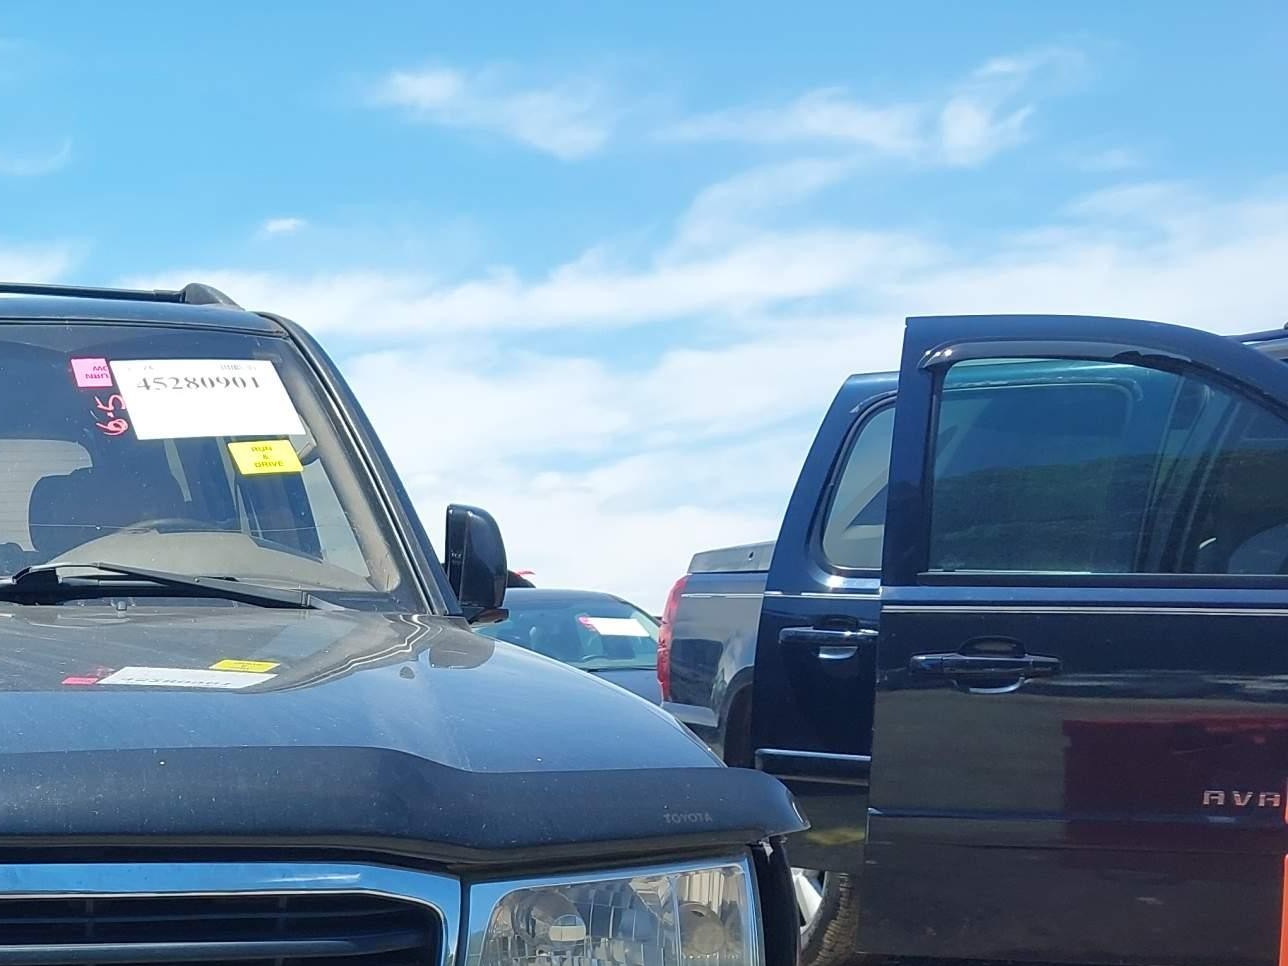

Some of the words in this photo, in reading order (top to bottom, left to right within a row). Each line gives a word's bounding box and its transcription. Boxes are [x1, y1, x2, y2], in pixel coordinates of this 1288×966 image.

[136, 376, 260, 391] 45280901
[254, 460, 285, 468] DRIVE
[663, 812, 713, 824] TOYOTA
